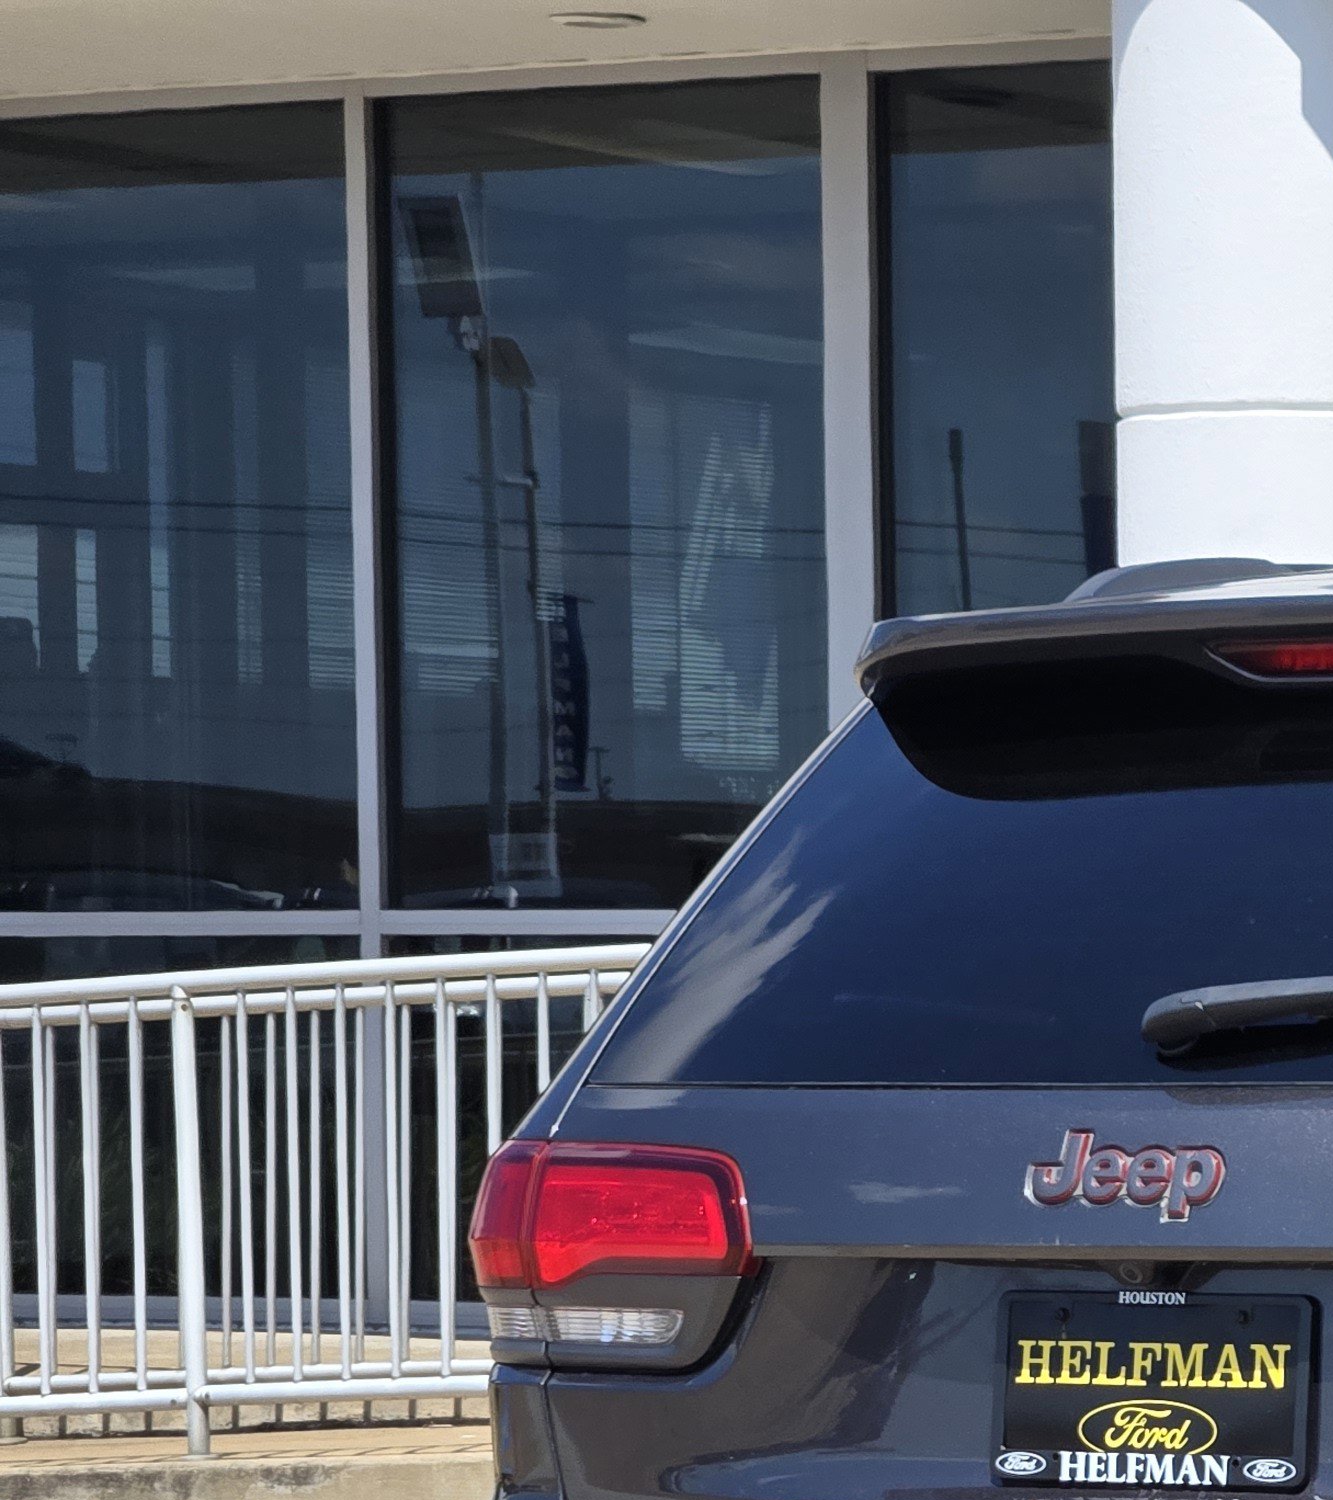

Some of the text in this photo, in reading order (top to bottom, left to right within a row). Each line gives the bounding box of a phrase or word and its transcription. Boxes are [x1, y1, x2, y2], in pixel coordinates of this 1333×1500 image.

[1024, 1128, 1227, 1223] Jeep
[1118, 1291, 1186, 1305] HOUSTON
[1015, 1339, 1291, 1389] HELFMAN
[1104, 1406, 1192, 1450] Ford
[1058, 1451, 1231, 1486] HELFMAN
